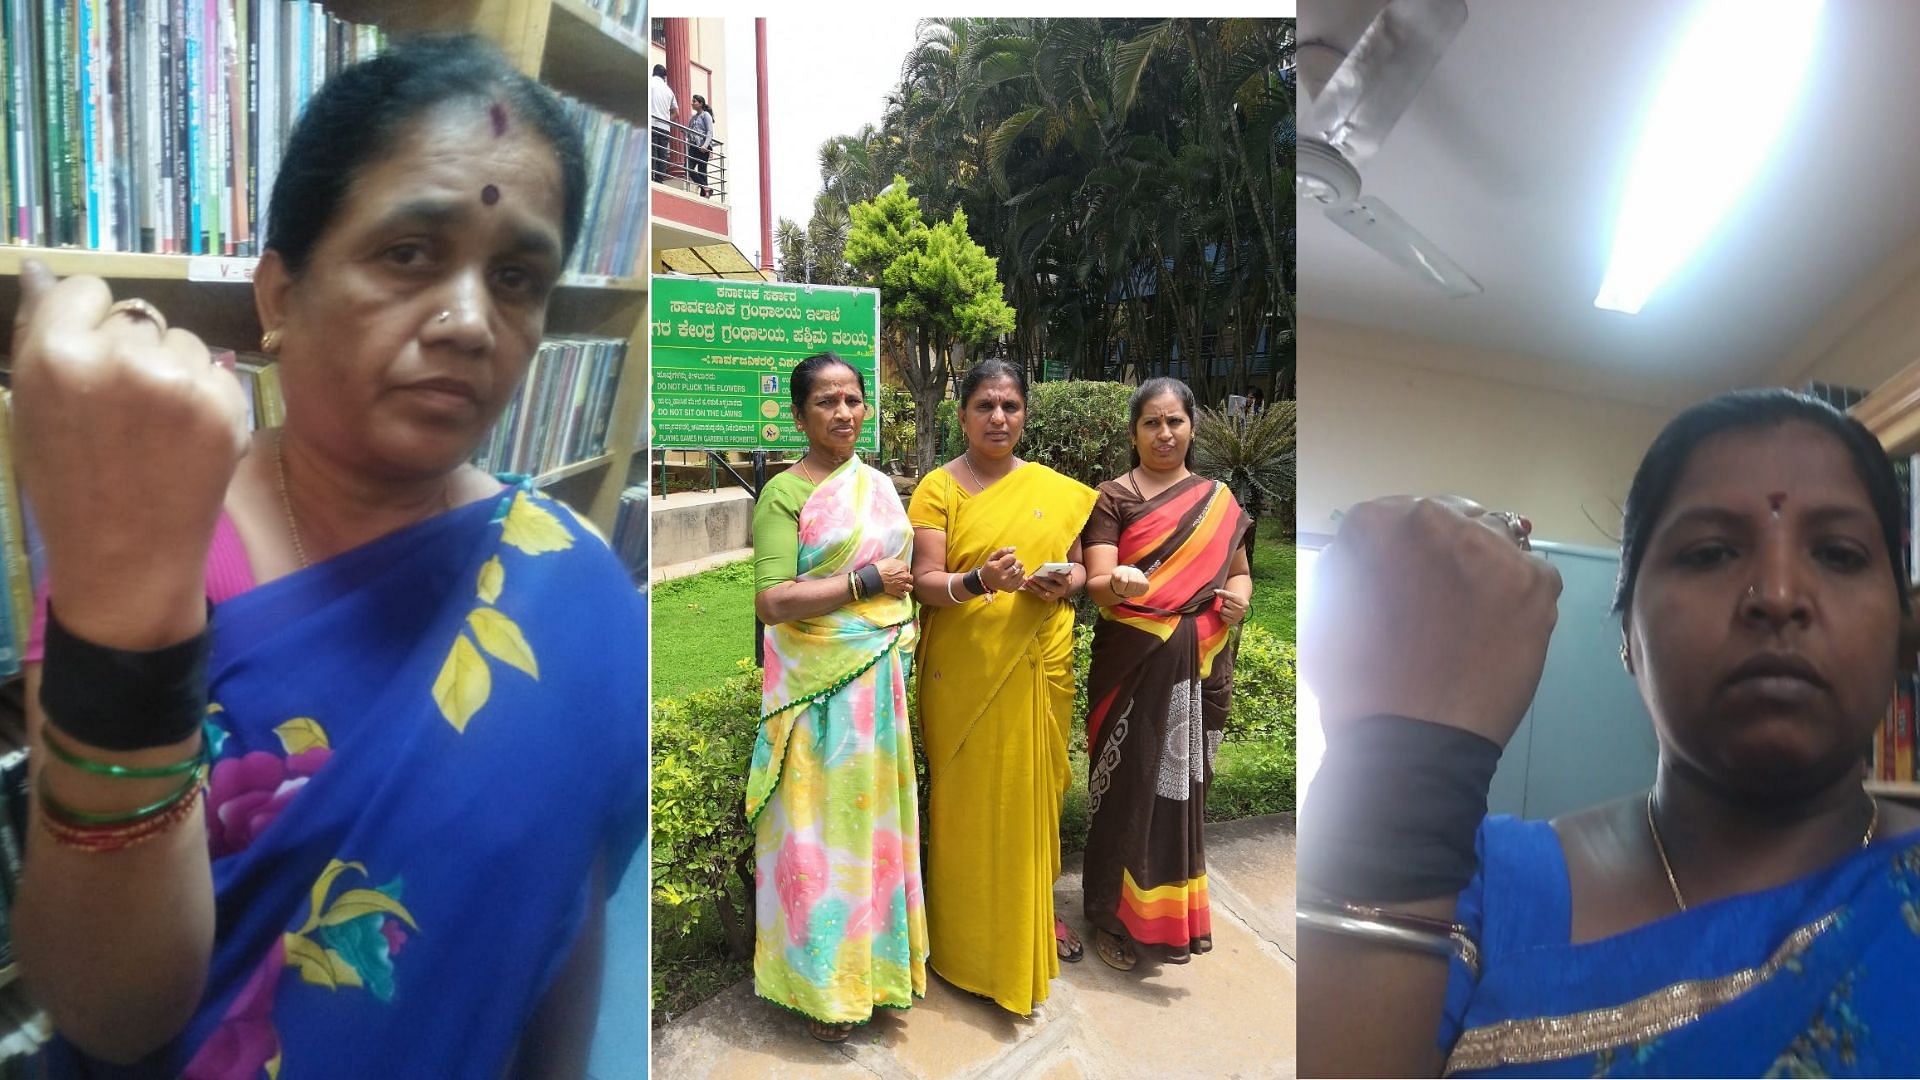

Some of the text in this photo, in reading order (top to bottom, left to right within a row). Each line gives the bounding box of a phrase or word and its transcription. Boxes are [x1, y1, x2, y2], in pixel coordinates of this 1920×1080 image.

[716, 286, 797, 302] ಕರ್ನಾಟಕ ಸರ್ಕಾರ
[670, 299, 841, 322] ಸಾರ್ವಜನಿಕ ಗ್ರಂಥಾಲಯ ಇಲಾಖೆ
[677, 319, 715, 343] ಕೇಂದ್ರ
[793, 326, 827, 349] ಪಶ್ಚಿಮ
[667, 383, 681, 391] NOT
[682, 383, 703, 391] PLUCK
[704, 384, 716, 392] THE
[716, 385, 746, 393] FLOWERS
[658, 408, 668, 416] DO
[696, 409, 706, 417] ON
[706, 409, 720, 417] THE
[720, 410, 743, 418] LAWNS
[658, 434, 680, 442] PLAYING
[680, 434, 697, 443] GAMES
[697, 435, 703, 443] IN
[703, 435, 724, 443] GARDEN
[729, 435, 758, 443] PROHIBITED
